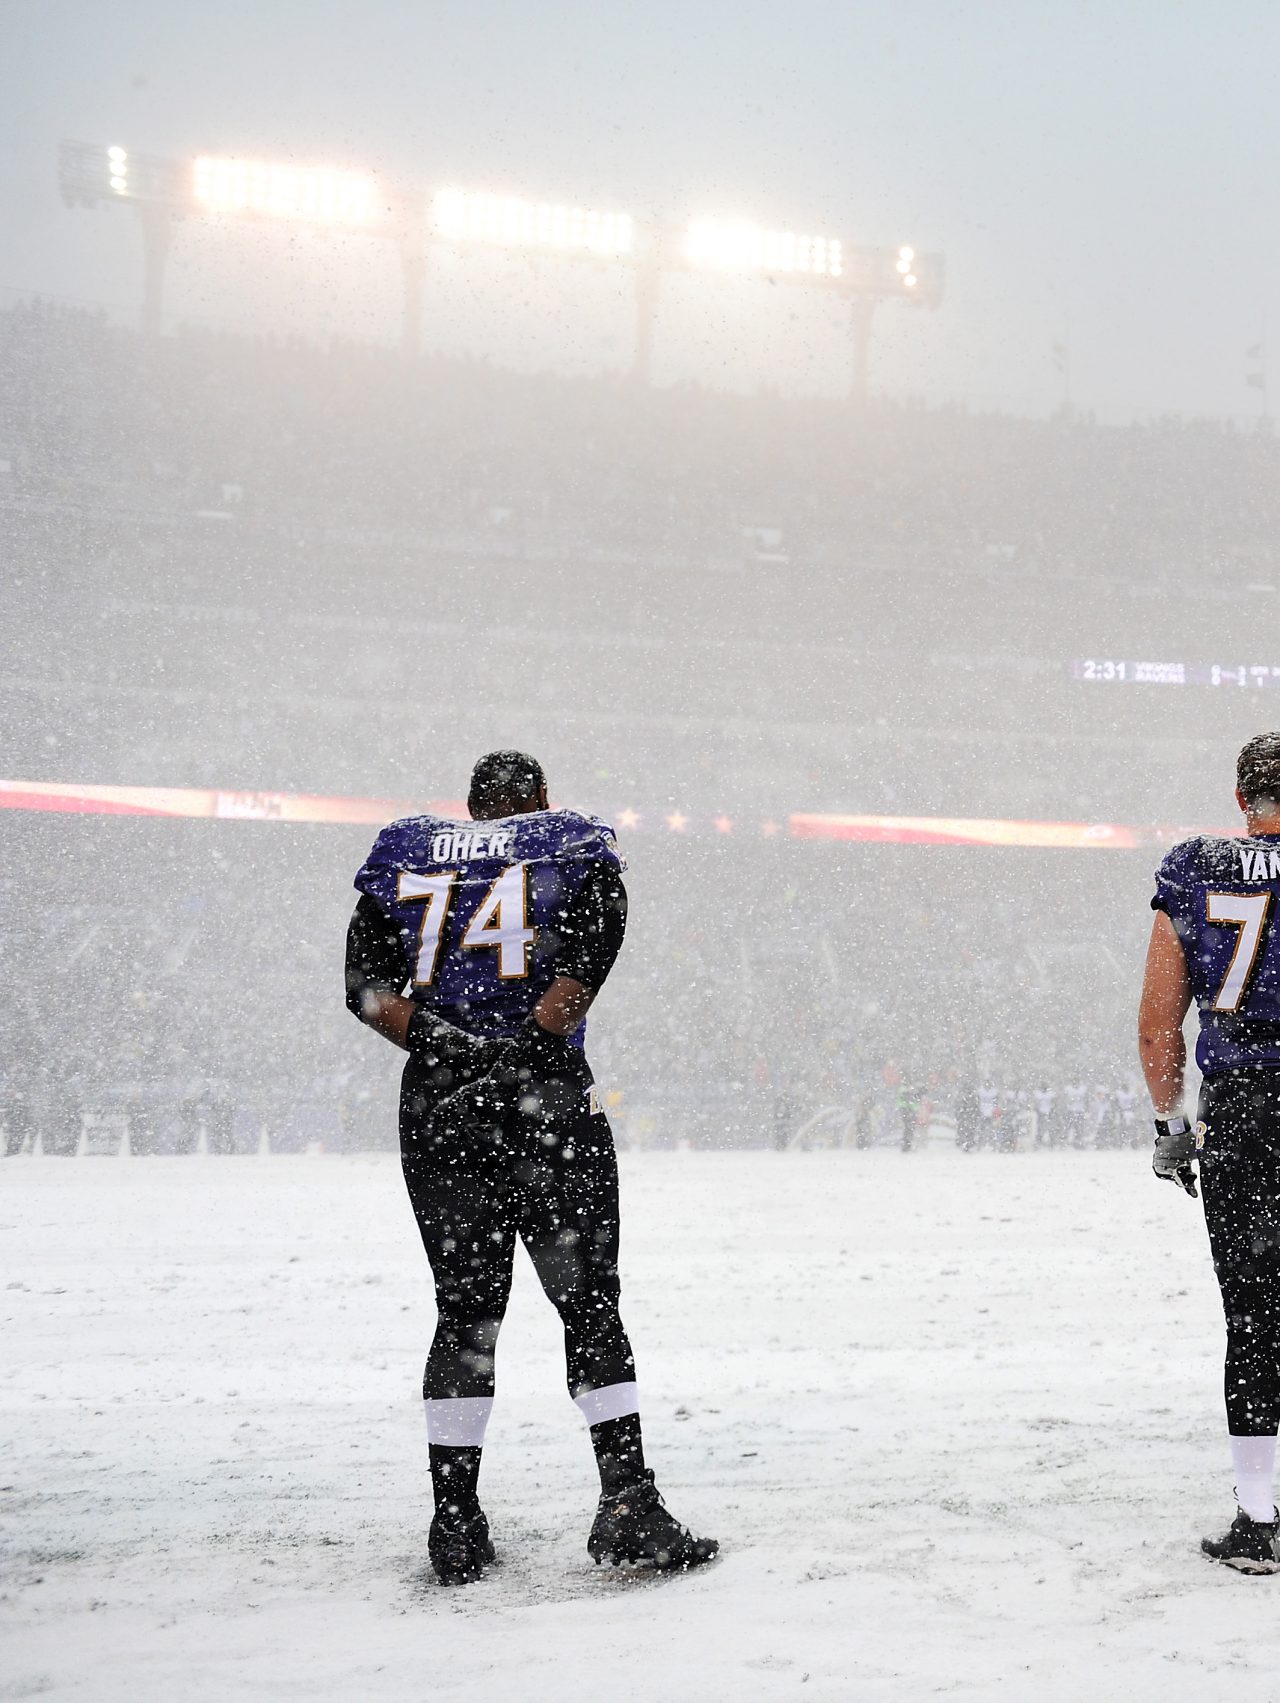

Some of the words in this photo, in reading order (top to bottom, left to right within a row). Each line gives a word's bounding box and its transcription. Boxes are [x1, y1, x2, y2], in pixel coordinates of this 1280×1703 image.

[1083, 660, 1126, 680] 2:31
[433, 832, 507, 863] OHER
[397, 864, 537, 986] 74
